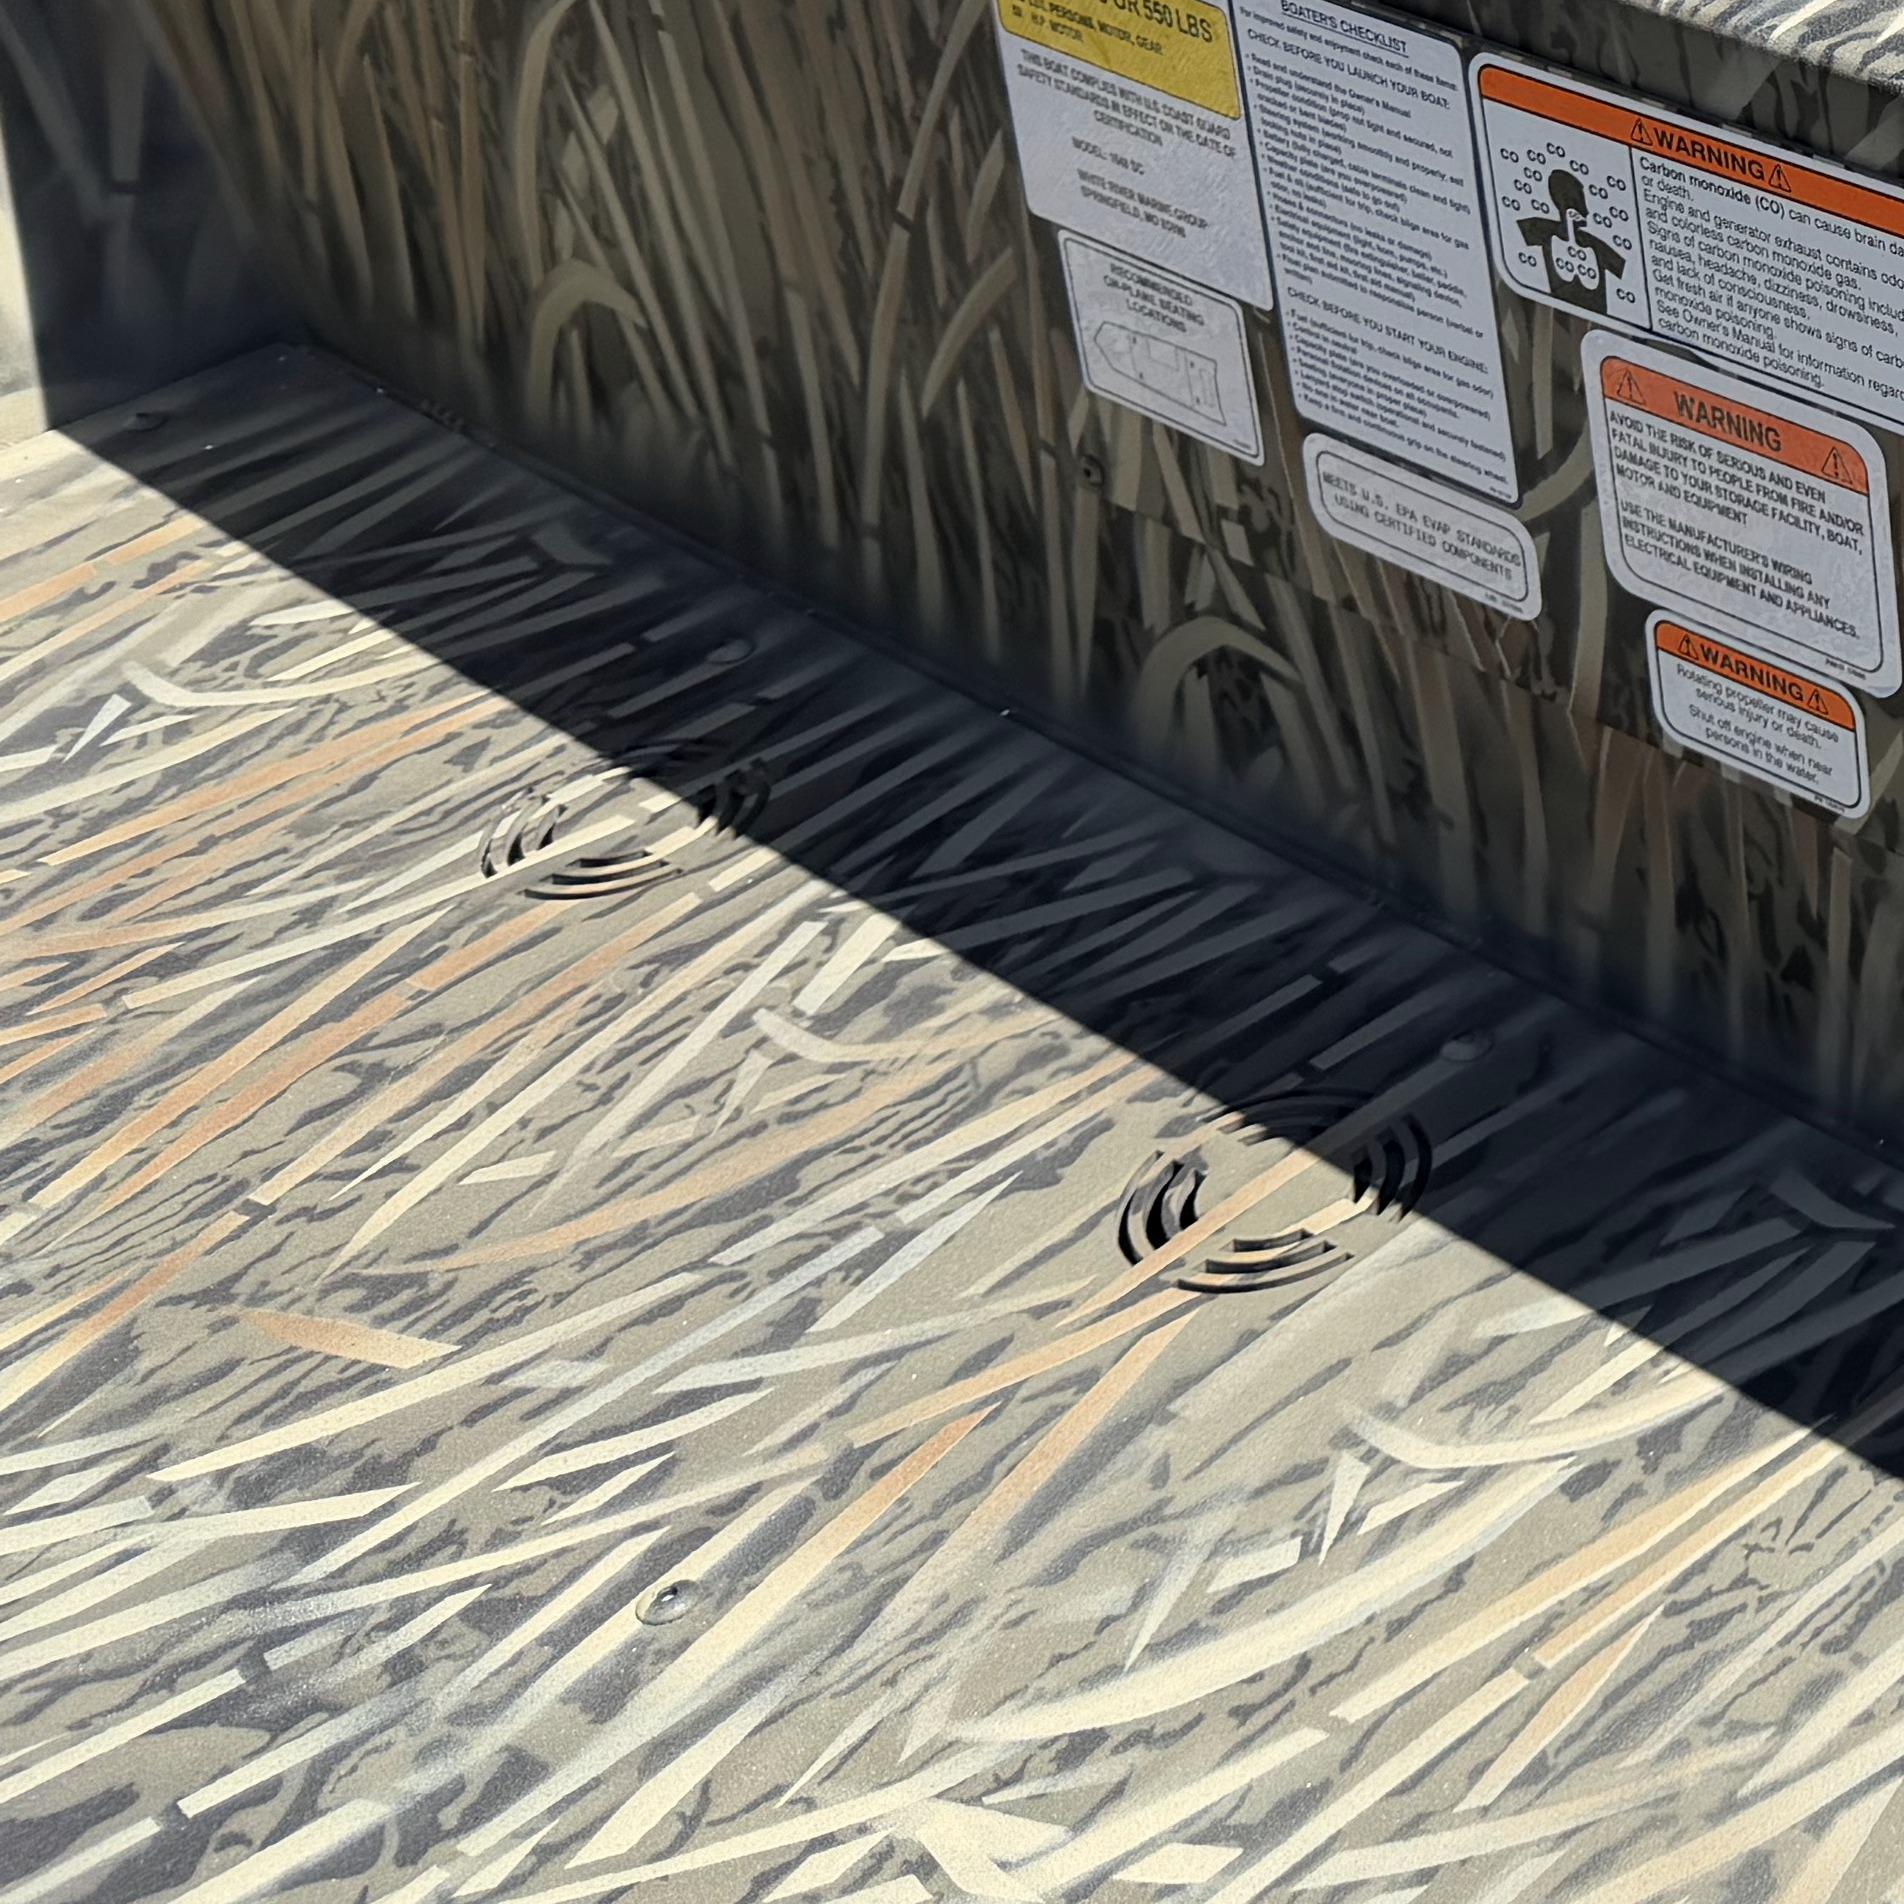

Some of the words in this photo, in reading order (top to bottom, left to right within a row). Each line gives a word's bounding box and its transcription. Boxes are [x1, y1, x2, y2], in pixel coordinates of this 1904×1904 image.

[1175, 8, 1213, 43] LBS
[1280, 0, 1338, 29] BOATER'S
[1339, 19, 1409, 57] CHECKLIST
[1500, 148, 1519, 163] CO
[1523, 166, 1543, 182] CO
[1526, 149, 1547, 165] CO
[1546, 142, 1566, 158] CO
[1569, 159, 1589, 176] CO
[1653, 127, 1765, 182] WARNING
[1501, 195, 1521, 212] CO
[1513, 179, 1533, 195] CO
[1530, 198, 1550, 215] CO
[1588, 184, 1608, 200] CO
[1606, 175, 1627, 191] CO
[1639, 156, 1686, 183] Carbon
[1688, 175, 1751, 205] monoxide
[1755, 195, 1785, 220] (CO)
[1788, 209, 1811, 225] can
[1814, 218, 1851, 240] cause
[1854, 228, 1886, 251] brain
[1641, 175, 1654, 188] or
[1656, 179, 1694, 202] death.
[1592, 212, 1613, 229] CO
[1608, 206, 1629, 222] CO
[1612, 234, 1633, 251] CO
[1643, 188, 1685, 214] Engine
[1687, 206, 1711, 223] and
[1713, 215, 1771, 244] generator
[1774, 236, 1824, 266] exhaust
[1825, 253, 1878, 281] contains
[1518, 252, 1537, 268] CO
[1567, 245, 1587, 262] CO
[1577, 263, 1597, 280] CO
[1645, 207, 1668, 224] and
[1671, 215, 1724, 243] colorless
[1726, 234, 1770, 259] carbon
[1772, 250, 1832, 281] monoxide
[1835, 272, 1861, 291] gas.
[1646, 220, 1681, 244] Signs
[1683, 235, 1695, 249] of
[1697, 240, 1740, 264] carbon
[1742, 256, 1802, 286] monoxide
[1805, 277, 1866, 312] poisoning
[1616, 288, 1636, 304] CO
[1649, 239, 1696, 267] nausea,
[1697, 254, 1761, 289] headache,
[1763, 278, 1822, 311] dizziness,
[1825, 300, 1898, 337] drowsiness,
[1651, 255, 1674, 272] and
[1676, 261, 1701, 282] lack
[1703, 273, 1715, 286] of
[1718, 278, 1810, 320] consciousness.
[1652, 268, 1675, 288] Get
[1676, 276, 1706, 298] fresh
[1708, 290, 1723, 304] air
[1726, 294, 1734, 308] if
[1736, 300, 1781, 325] anyone
[1783, 316, 1823, 340] shows
[1825, 332, 1858, 353] signs
[1860, 344, 1873, 358] of
[1654, 286, 1712, 316] monoxide
[1715, 308, 1777, 340] poisoning.
[1656, 299, 1680, 324] See
[1682, 308, 1730, 337] Owner's
[1732, 326, 1776, 354] Manual
[1777, 343, 1794, 360] for
[1797, 350, 1865, 386] information
[1658, 317, 1700, 342] carbon
[1702, 333, 1760, 364] monoxide
[1762, 355, 1825, 389] poisoning.
[1673, 391, 1781, 452] WARNING
[1610, 410, 1644, 434] AVOID
[1645, 423, 1668, 443] THE
[1669, 432, 1697, 454] RISK
[1698, 444, 1713, 460] OF
[1716, 450, 1767, 481] SERIOUS
[1768, 471, 1793, 491] AND
[1795, 480, 1826, 504] EVEN
[1611, 427, 1647, 452] FATAL
[1649, 442, 1688, 468] INJURY
[1690, 458, 1707, 475] TO
[1708, 464, 1754, 494] PEOPLE
[1755, 482, 1789, 507] FROM
[1790, 496, 1817, 518] FIRE
[1819, 508, 1865, 537] AND/OR
[1614, 445, 1661, 476] DAMAGE
[1662, 464, 1679, 481] TO
[1680, 471, 1714, 496] YOUR
[1714, 484, 1770, 517] STORAGE
[1826, 528, 1863, 556] BOAT,
[1616, 462, 1656, 489] MOTOR
[1658, 480, 1681, 499] AND
[1683, 489, 1748, 525] EQUIPMENT
[1620, 499, 1643, 518] USE
[1643, 507, 1666, 527] THE
[1668, 517, 1769, 569] MANUFACTURER'S
[1771, 558, 1813, 586] WIRING
[1622, 515, 1702, 558] INSTRUCTIONS
[1703, 548, 1737, 573] WHEN
[1739, 562, 1805, 600] INSTALLING
[1807, 590, 1830, 610] ANY
[1624, 533, 1692, 571] ELECTRICAL
[1692, 561, 1757, 597] EQUIPMENT
[1759, 588, 1784, 608] AND
[1785, 598, 1860, 640] APPLIANCES.
[1700, 643, 1804, 703] WARNING
[1676, 663, 1723, 696] Rotating
[1725, 686, 1775, 715] propeller
[1777, 708, 1802, 729] may
[1804, 720, 1839, 743] cause
[1695, 688, 1736, 713] serious
[1738, 703, 1769, 729] injury
[1771, 719, 1784, 733] or
[1786, 726, 1822, 750] death.
[1688, 704, 1715, 726] Shut
[1717, 718, 1732, 732] off
[1733, 725, 1772, 750] engine
[1774, 743, 1805, 765] when
[1807, 757, 1833, 776] near
[1705, 727, 1750, 754] persons
[1749, 743, 1763, 760] in
[1765, 750, 1783, 769] the
[1785, 762, 1819, 785] water.
